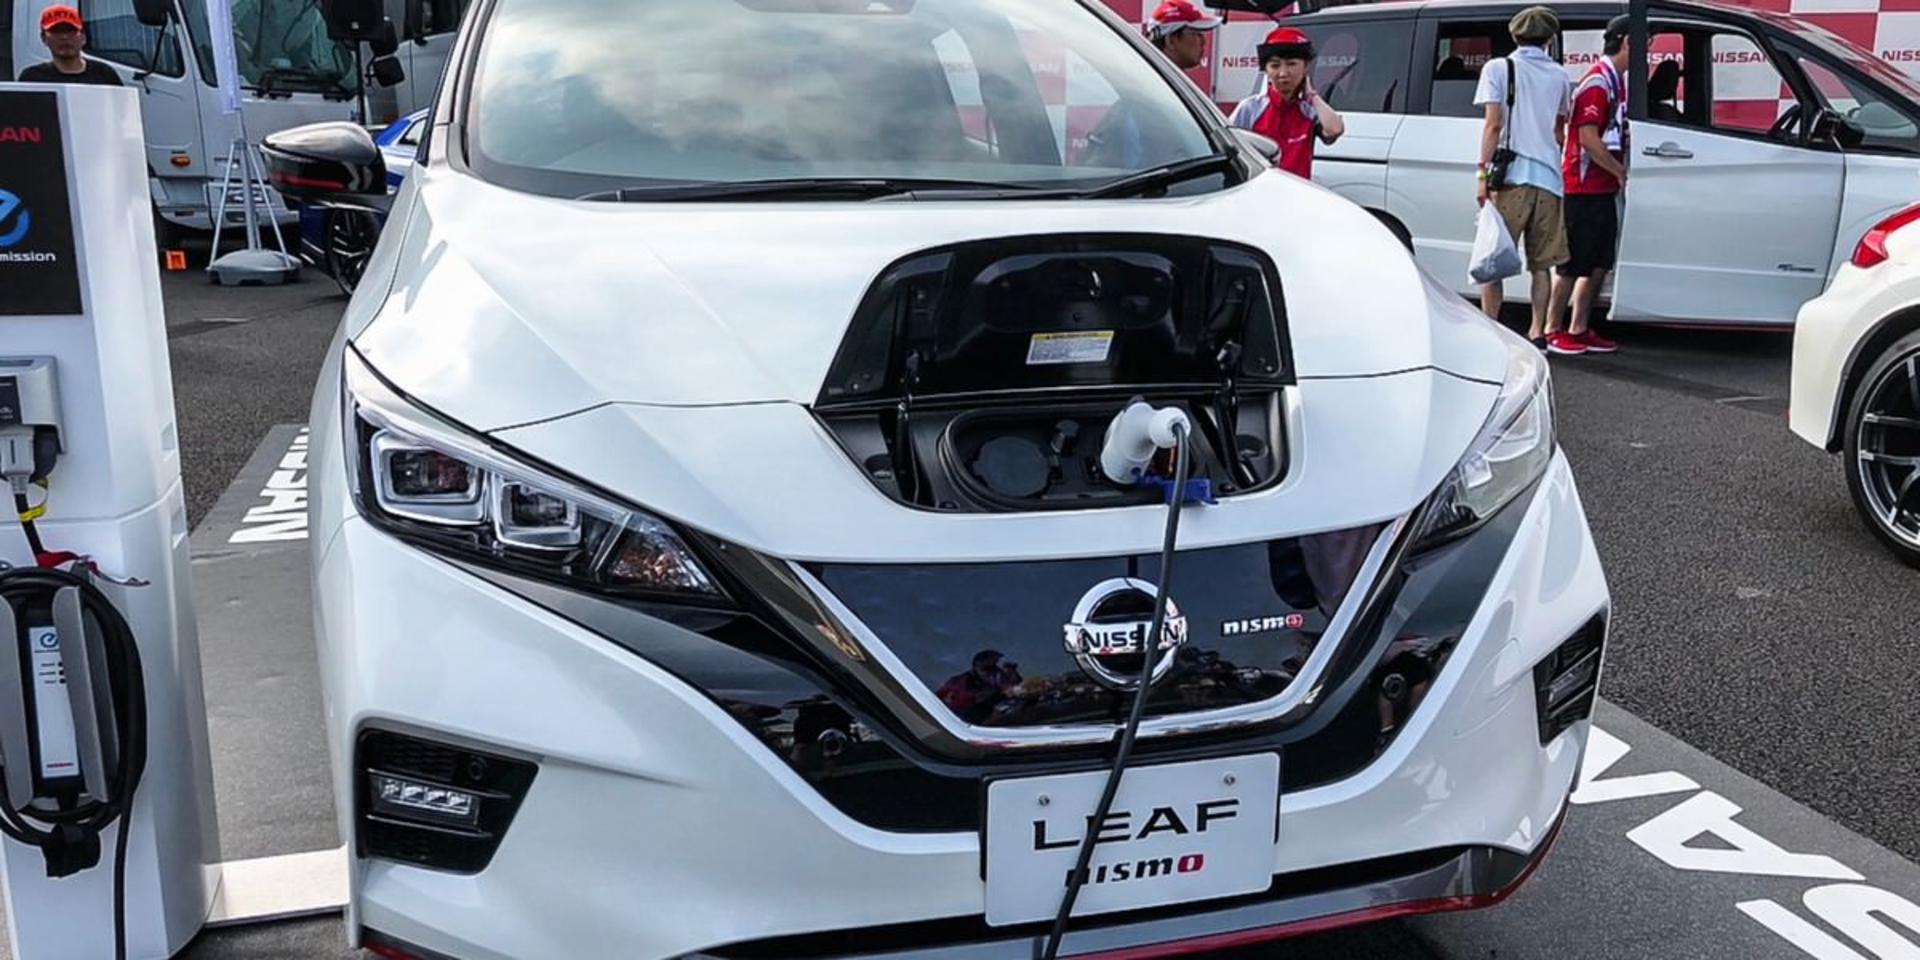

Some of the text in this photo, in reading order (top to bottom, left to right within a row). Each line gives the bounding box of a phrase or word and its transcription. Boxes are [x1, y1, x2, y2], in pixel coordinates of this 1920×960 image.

[1081, 622, 1179, 650] NISSN
[1223, 613, 1304, 636] nismo
[1033, 799, 1239, 850] LEAF
[1064, 853, 1204, 888] nismo
